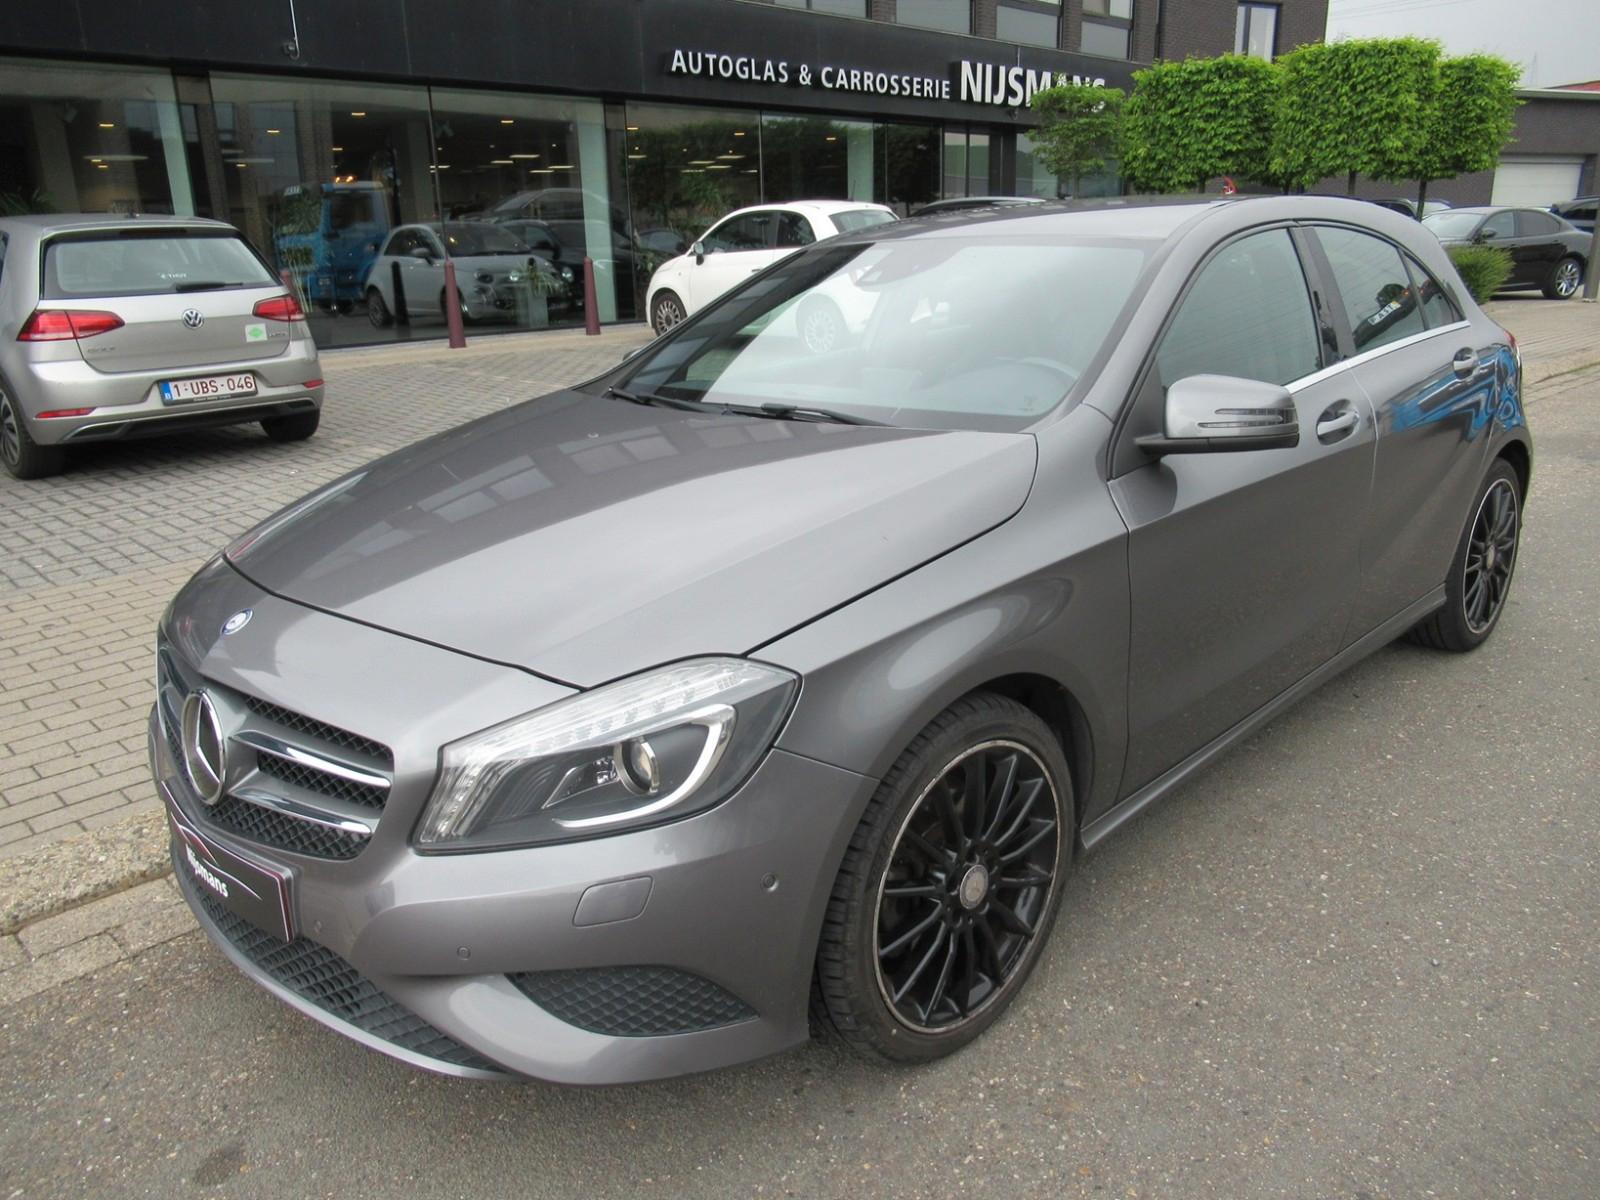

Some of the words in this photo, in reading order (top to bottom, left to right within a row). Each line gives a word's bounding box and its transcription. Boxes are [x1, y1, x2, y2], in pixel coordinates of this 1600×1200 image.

[671, 49, 789, 83] AUTOGLAS
[799, 64, 812, 86] &
[821, 66, 950, 99] CARROSSERIE
[960, 60, 1106, 112] NIJSM
[173, 375, 253, 397] 1-UBS-046
